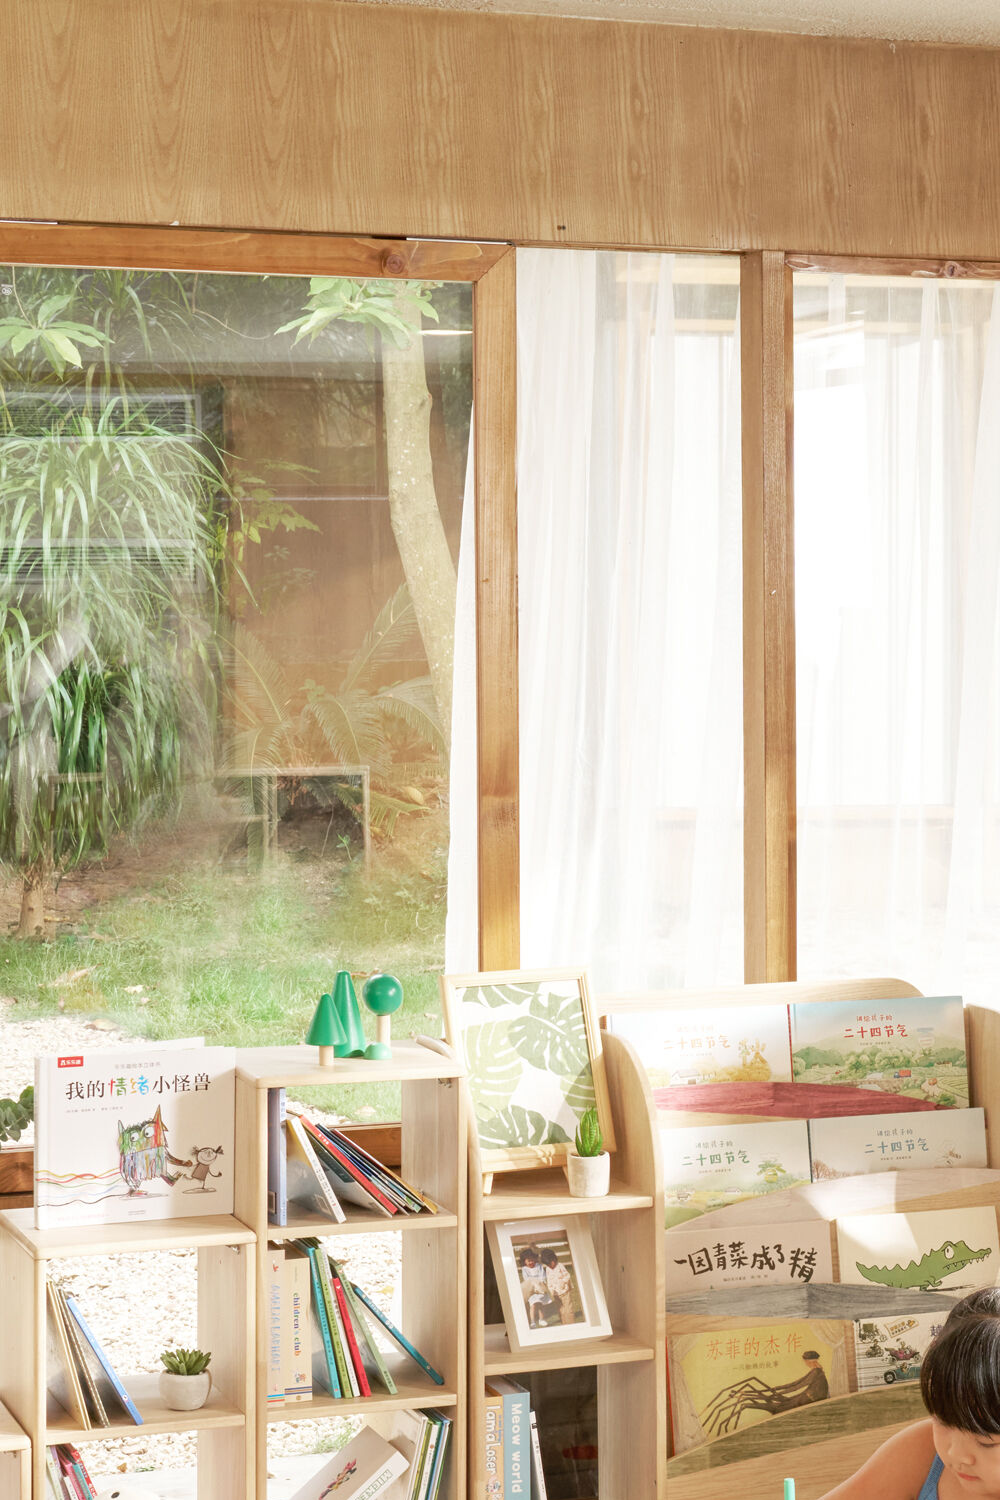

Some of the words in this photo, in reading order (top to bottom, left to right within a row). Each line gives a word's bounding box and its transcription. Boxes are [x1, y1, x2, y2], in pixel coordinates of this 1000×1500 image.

[663, 1034, 731, 1051] 二十四节气
[843, 1024, 909, 1039] 二十四节气
[65, 1072, 212, 1100] 我的情绪小怪兽
[682, 1149, 750, 1167] 二十四节气
[864, 1138, 929, 1154] 二十四节气
[674, 1241, 818, 1283] 一园青菜成了精
[293, 1337, 301, 1357] club
[705, 1332, 803, 1361] 苏菲的杰作
[511, 1403, 523, 1446] Meow
[485, 1442, 501, 1475] Loser
[511, 1450, 523, 1493] world
